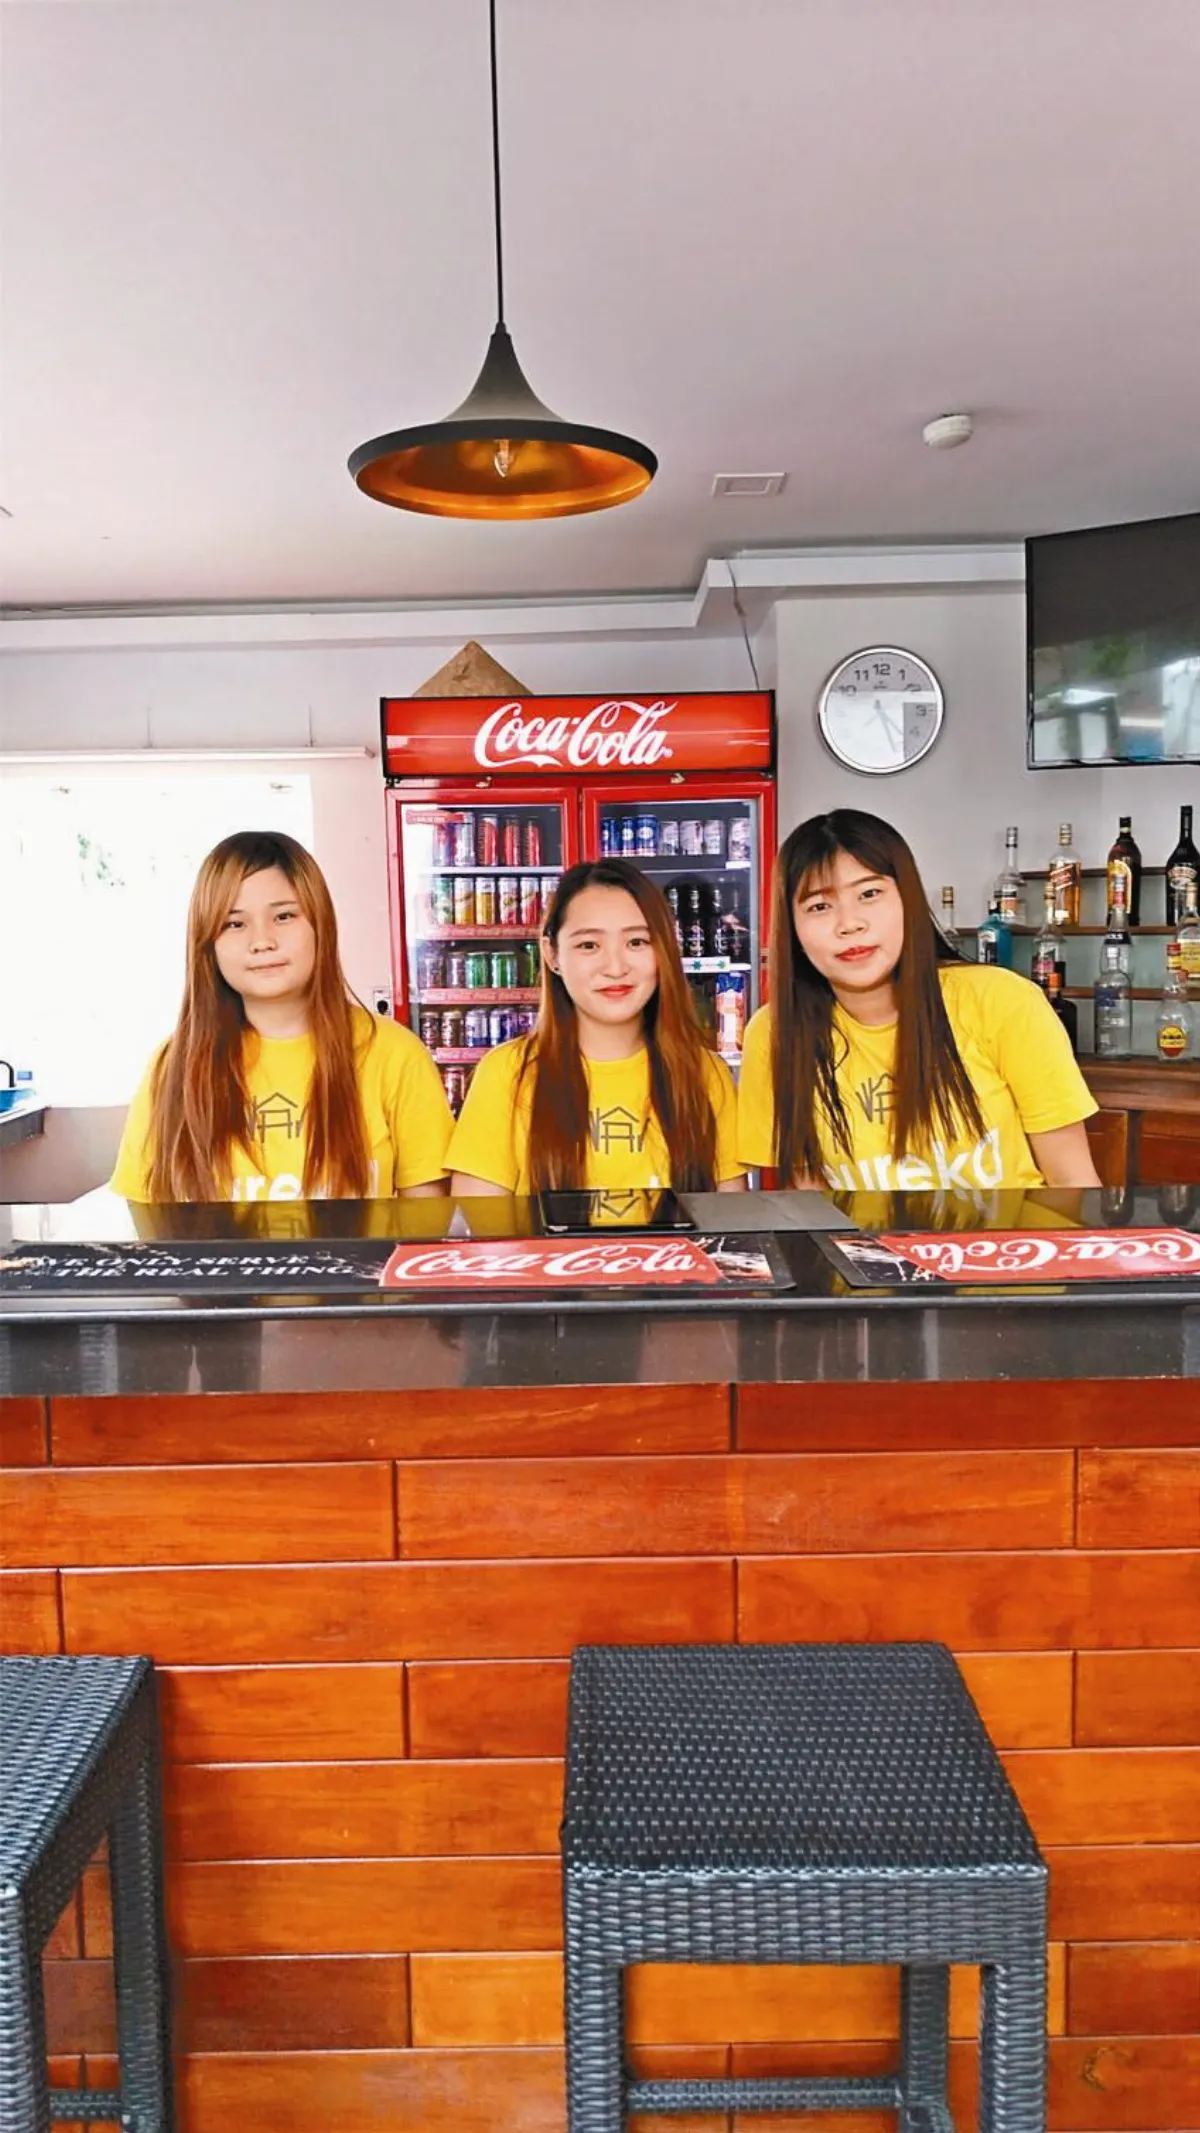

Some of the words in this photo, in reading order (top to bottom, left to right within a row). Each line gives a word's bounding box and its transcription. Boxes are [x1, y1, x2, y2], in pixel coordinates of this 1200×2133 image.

[853, 669, 869, 681] 11
[872, 663, 891, 676] 12
[898, 668, 906, 681] 1
[838, 684, 857, 697] 10
[915, 704, 927, 717] 3
[474, 700, 677, 768] Coca-Cola
[96, 1256, 192, 1267] ONLY
[196, 1255, 310, 1266] SERVE
[395, 1243, 697, 1278] Coca-Cola
[56, 1267, 127, 1277] THE
[134, 1267, 229, 1276] REAL
[240, 1266, 354, 1275] THING
